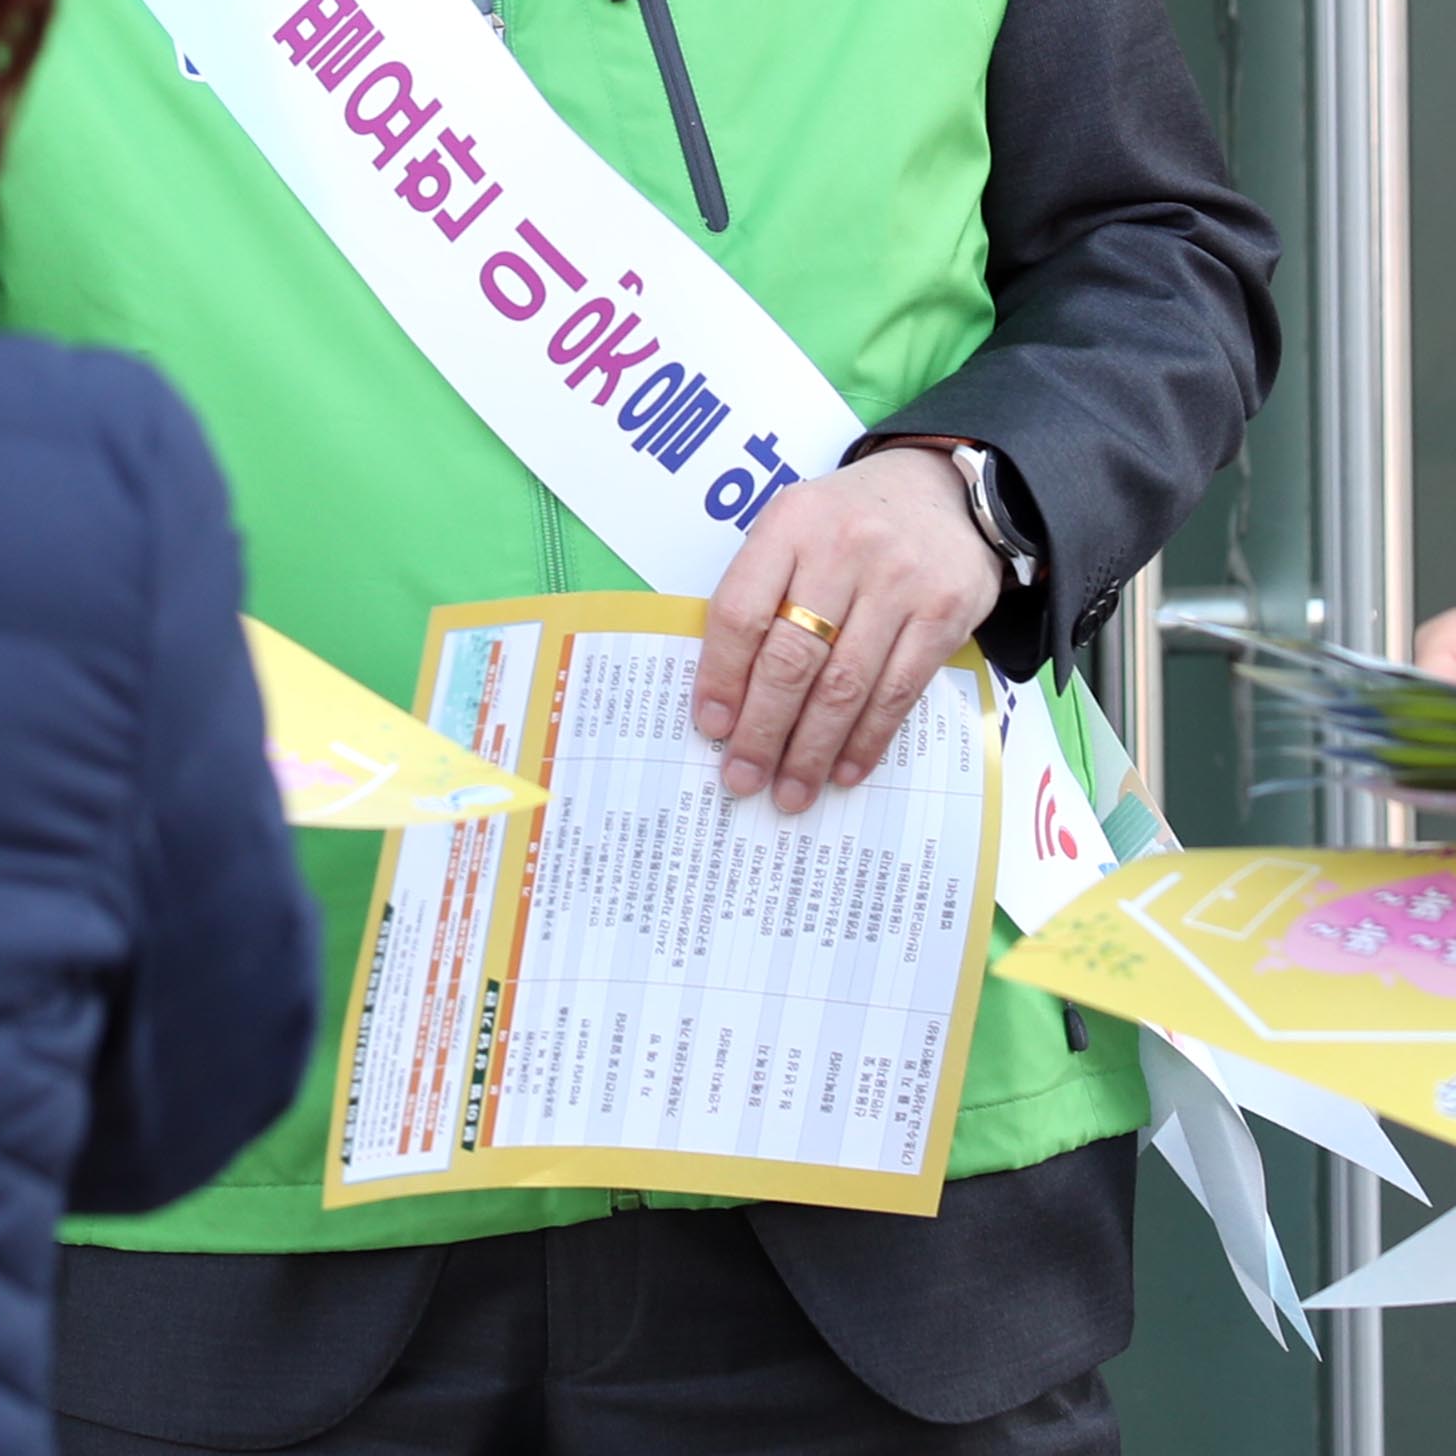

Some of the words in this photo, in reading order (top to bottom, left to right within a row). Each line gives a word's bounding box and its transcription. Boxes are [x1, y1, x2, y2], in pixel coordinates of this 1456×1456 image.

[478, 217, 732, 475] 이웃'을
[671, 658, 696, 740] 032)764-1183
[936, 713, 946, 742] 1397
[679, 790, 693, 811] 상담
[668, 860, 680, 871] 및
[671, 814, 689, 856] 정신건강
[767, 829, 791, 892] 노인복지센터
[816, 843, 832, 865] 전화
[720, 836, 747, 920] 동구치매안심센터
[741, 844, 767, 917] 동구노인복지관
[780, 834, 812, 937] 동구한마음종합복지관
[809, 867, 826, 898] 청소년
[864, 849, 894, 943] 송림종합사회복지관
[887, 861, 912, 934] 신용회복위원회
[902, 837, 937, 963] 인천서민금융통합지원센터
[653, 919, 670, 954] 24시간
[819, 1050, 842, 1113] 종합복지상담
[862, 1055, 876, 1066] 및
[868, 1056, 891, 1120] 서민금융지원
[853, 1072, 873, 1117] 신용회복
